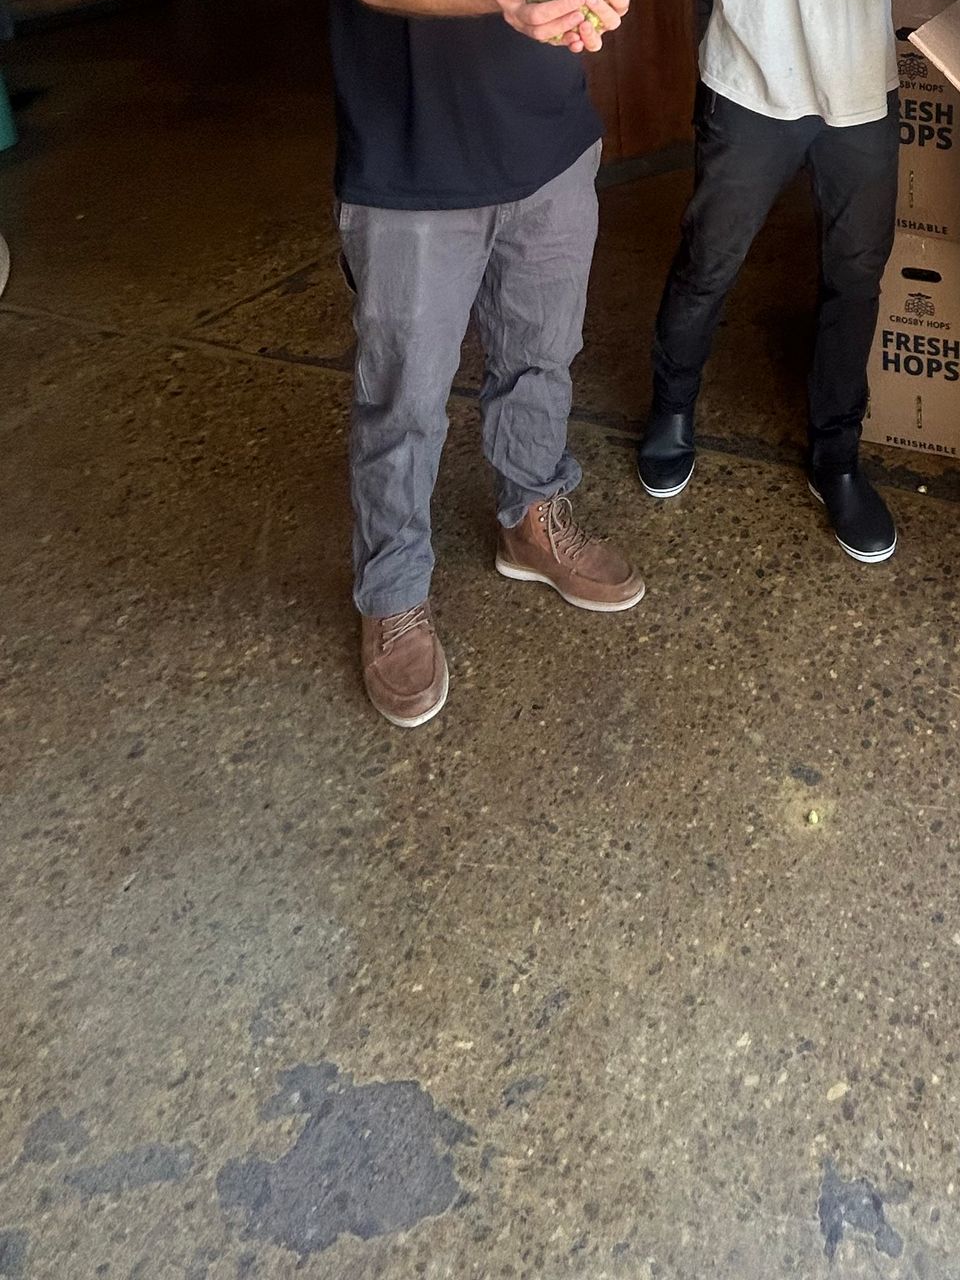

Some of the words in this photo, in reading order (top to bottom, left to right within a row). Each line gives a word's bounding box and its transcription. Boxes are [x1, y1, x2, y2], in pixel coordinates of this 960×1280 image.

[919, 83, 944, 93] HOPS
[899, 122, 953, 151] OPS
[896, 219, 948, 235] ISHABLE
[889, 315, 924, 327] CROSBY
[927, 320, 951, 330] HOPS
[882, 330, 960, 360] FRESH
[882, 351, 960, 381] HOPS
[886, 435, 957, 455] PERISHABLE
